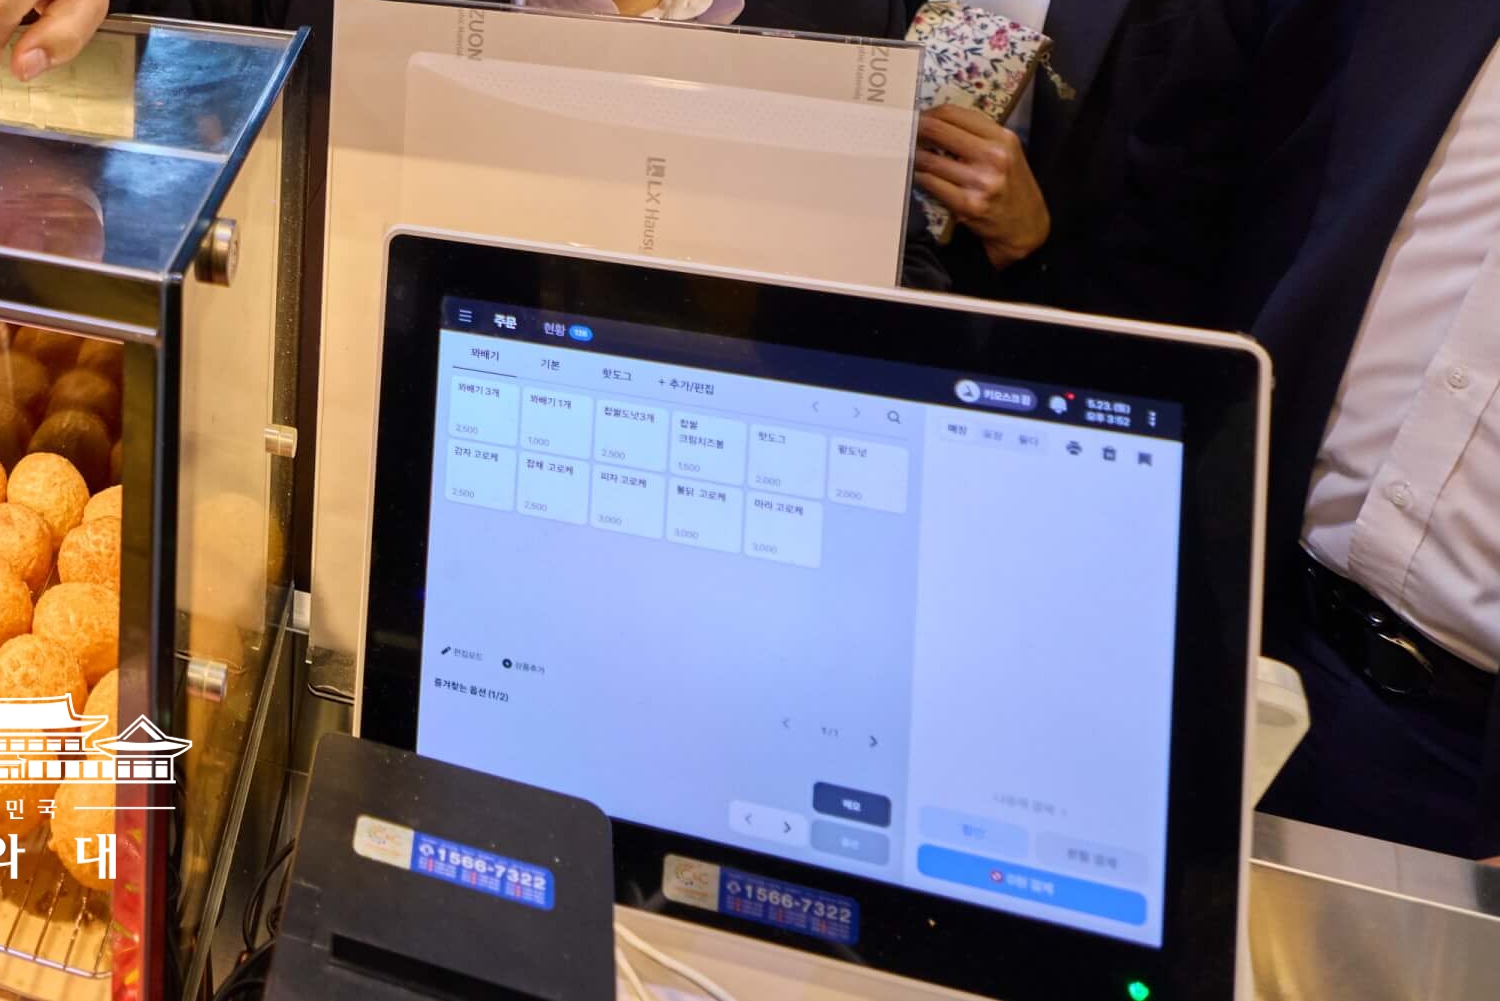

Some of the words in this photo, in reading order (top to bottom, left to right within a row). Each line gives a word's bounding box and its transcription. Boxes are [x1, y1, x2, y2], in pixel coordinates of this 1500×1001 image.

[493, 313, 518, 330] 주문
[471, 347, 500, 361] 꽈배기
[540, 359, 560, 371] 기본
[602, 367, 632, 382] 핫도그
[485, 388, 500, 400] 3개
[669, 378, 715, 396] 추가/편집
[454, 445, 472, 458] 감자
[474, 449, 499, 463] 고로케
[547, 463, 574, 476] 고로케
[600, 472, 618, 484] 피자
[621, 475, 647, 489] 고로케
[488, 689, 509, 702] (1/2)
[437, 846, 547, 891] 1566-7322
[744, 883, 852, 924] 1566-7322
